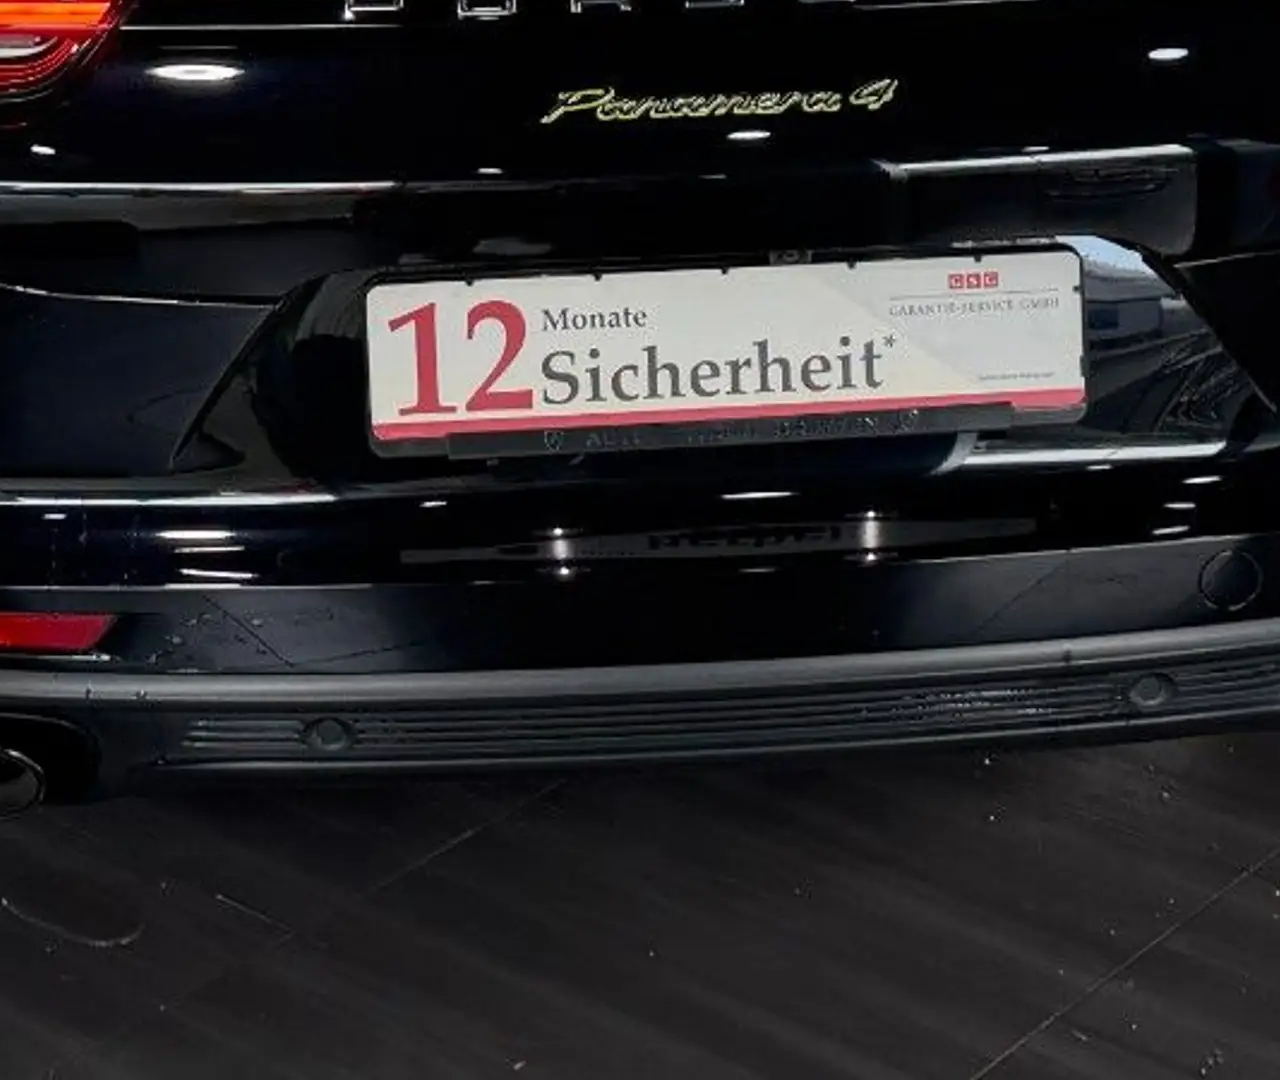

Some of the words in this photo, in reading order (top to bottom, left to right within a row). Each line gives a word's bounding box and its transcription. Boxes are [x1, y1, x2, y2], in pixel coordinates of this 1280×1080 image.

[539, 86, 843, 124] Panamera
[848, 77, 900, 111] 4
[541, 306, 648, 332] Monate
[386, 299, 534, 417] 12
